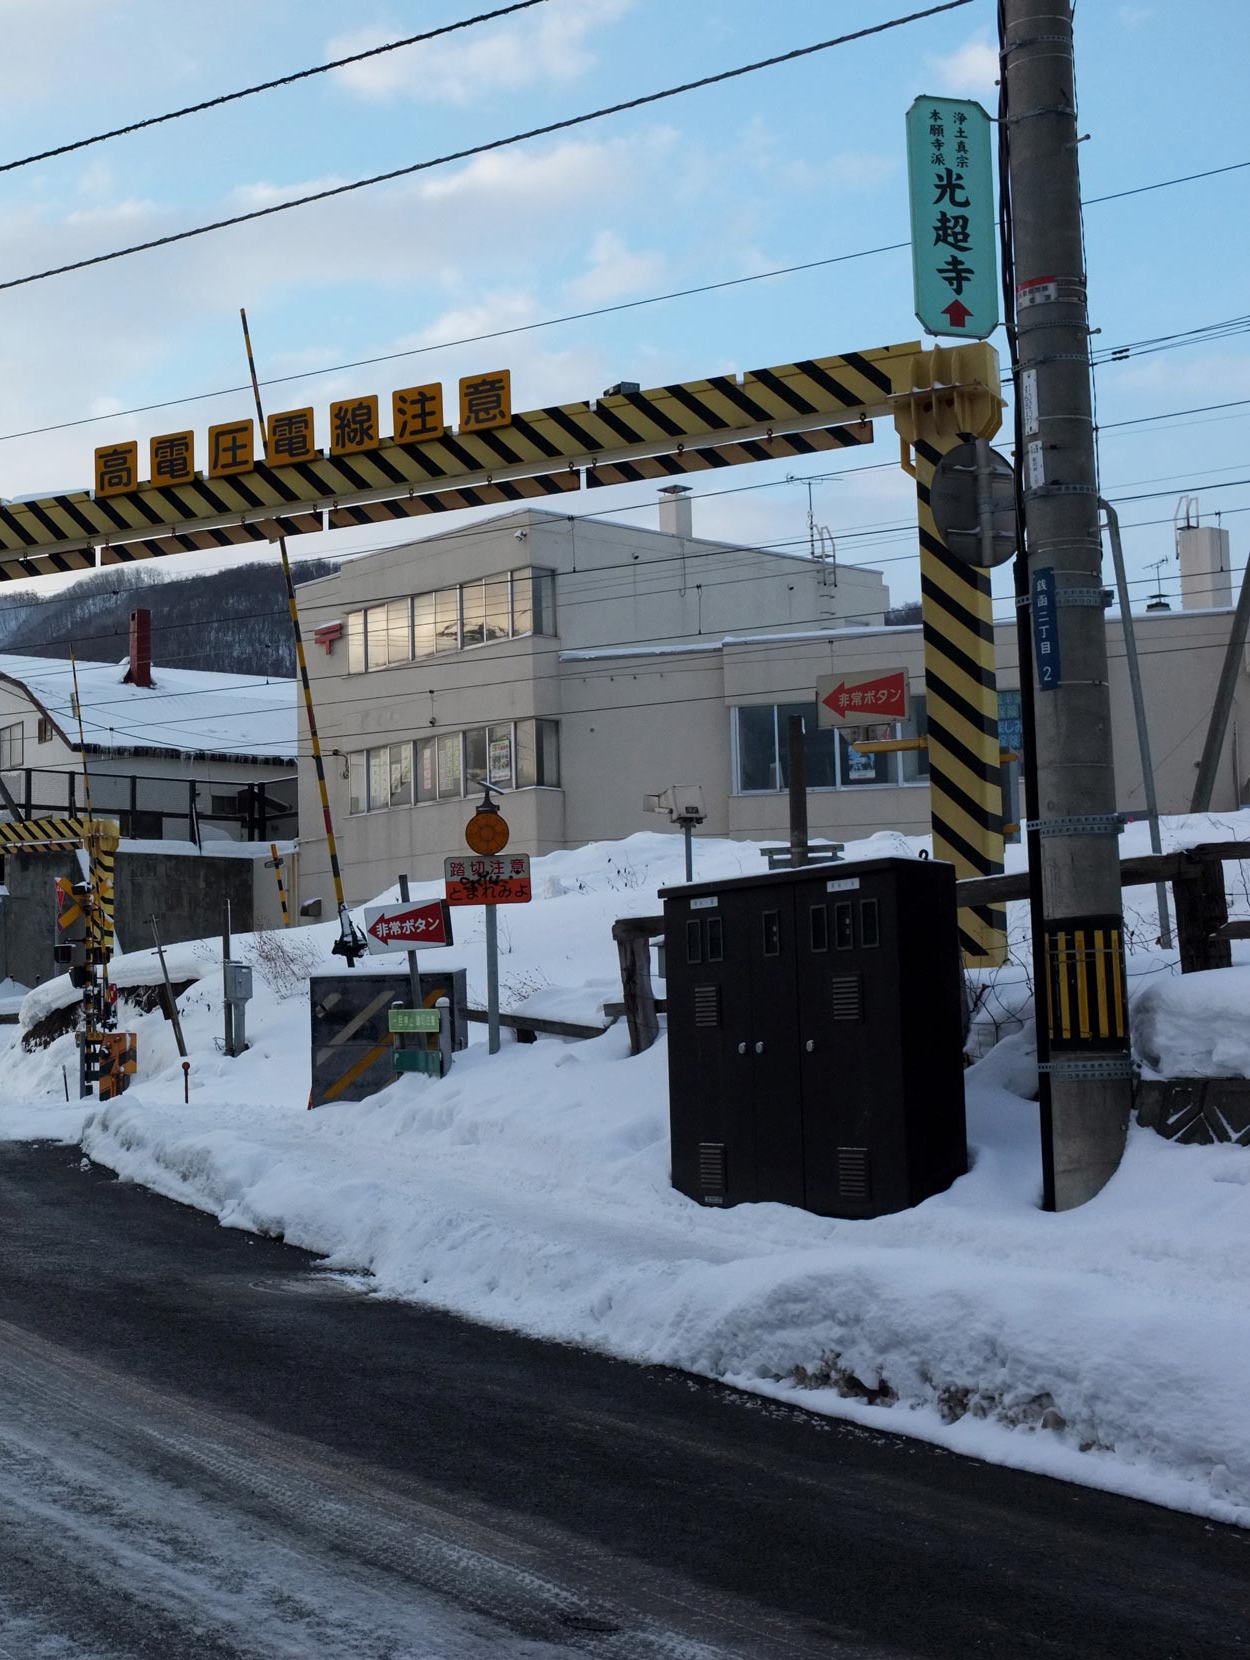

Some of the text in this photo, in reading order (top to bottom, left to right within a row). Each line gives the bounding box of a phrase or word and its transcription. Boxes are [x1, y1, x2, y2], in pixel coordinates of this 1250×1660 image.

[928, 109, 946, 166] 本願寺派
[953, 111, 969, 168] 浄土真宗
[932, 166, 975, 297] 光超寺
[98, 377, 507, 494] 高電圧電線注意
[1036, 578, 1052, 682] 銭函二丁目 2
[838, 686, 902, 708] 非常ボタン
[449, 882, 529, 901] とまれみよ
[450, 858, 525, 878] 踏切注意
[376, 917, 440, 938] 非常ボタン
